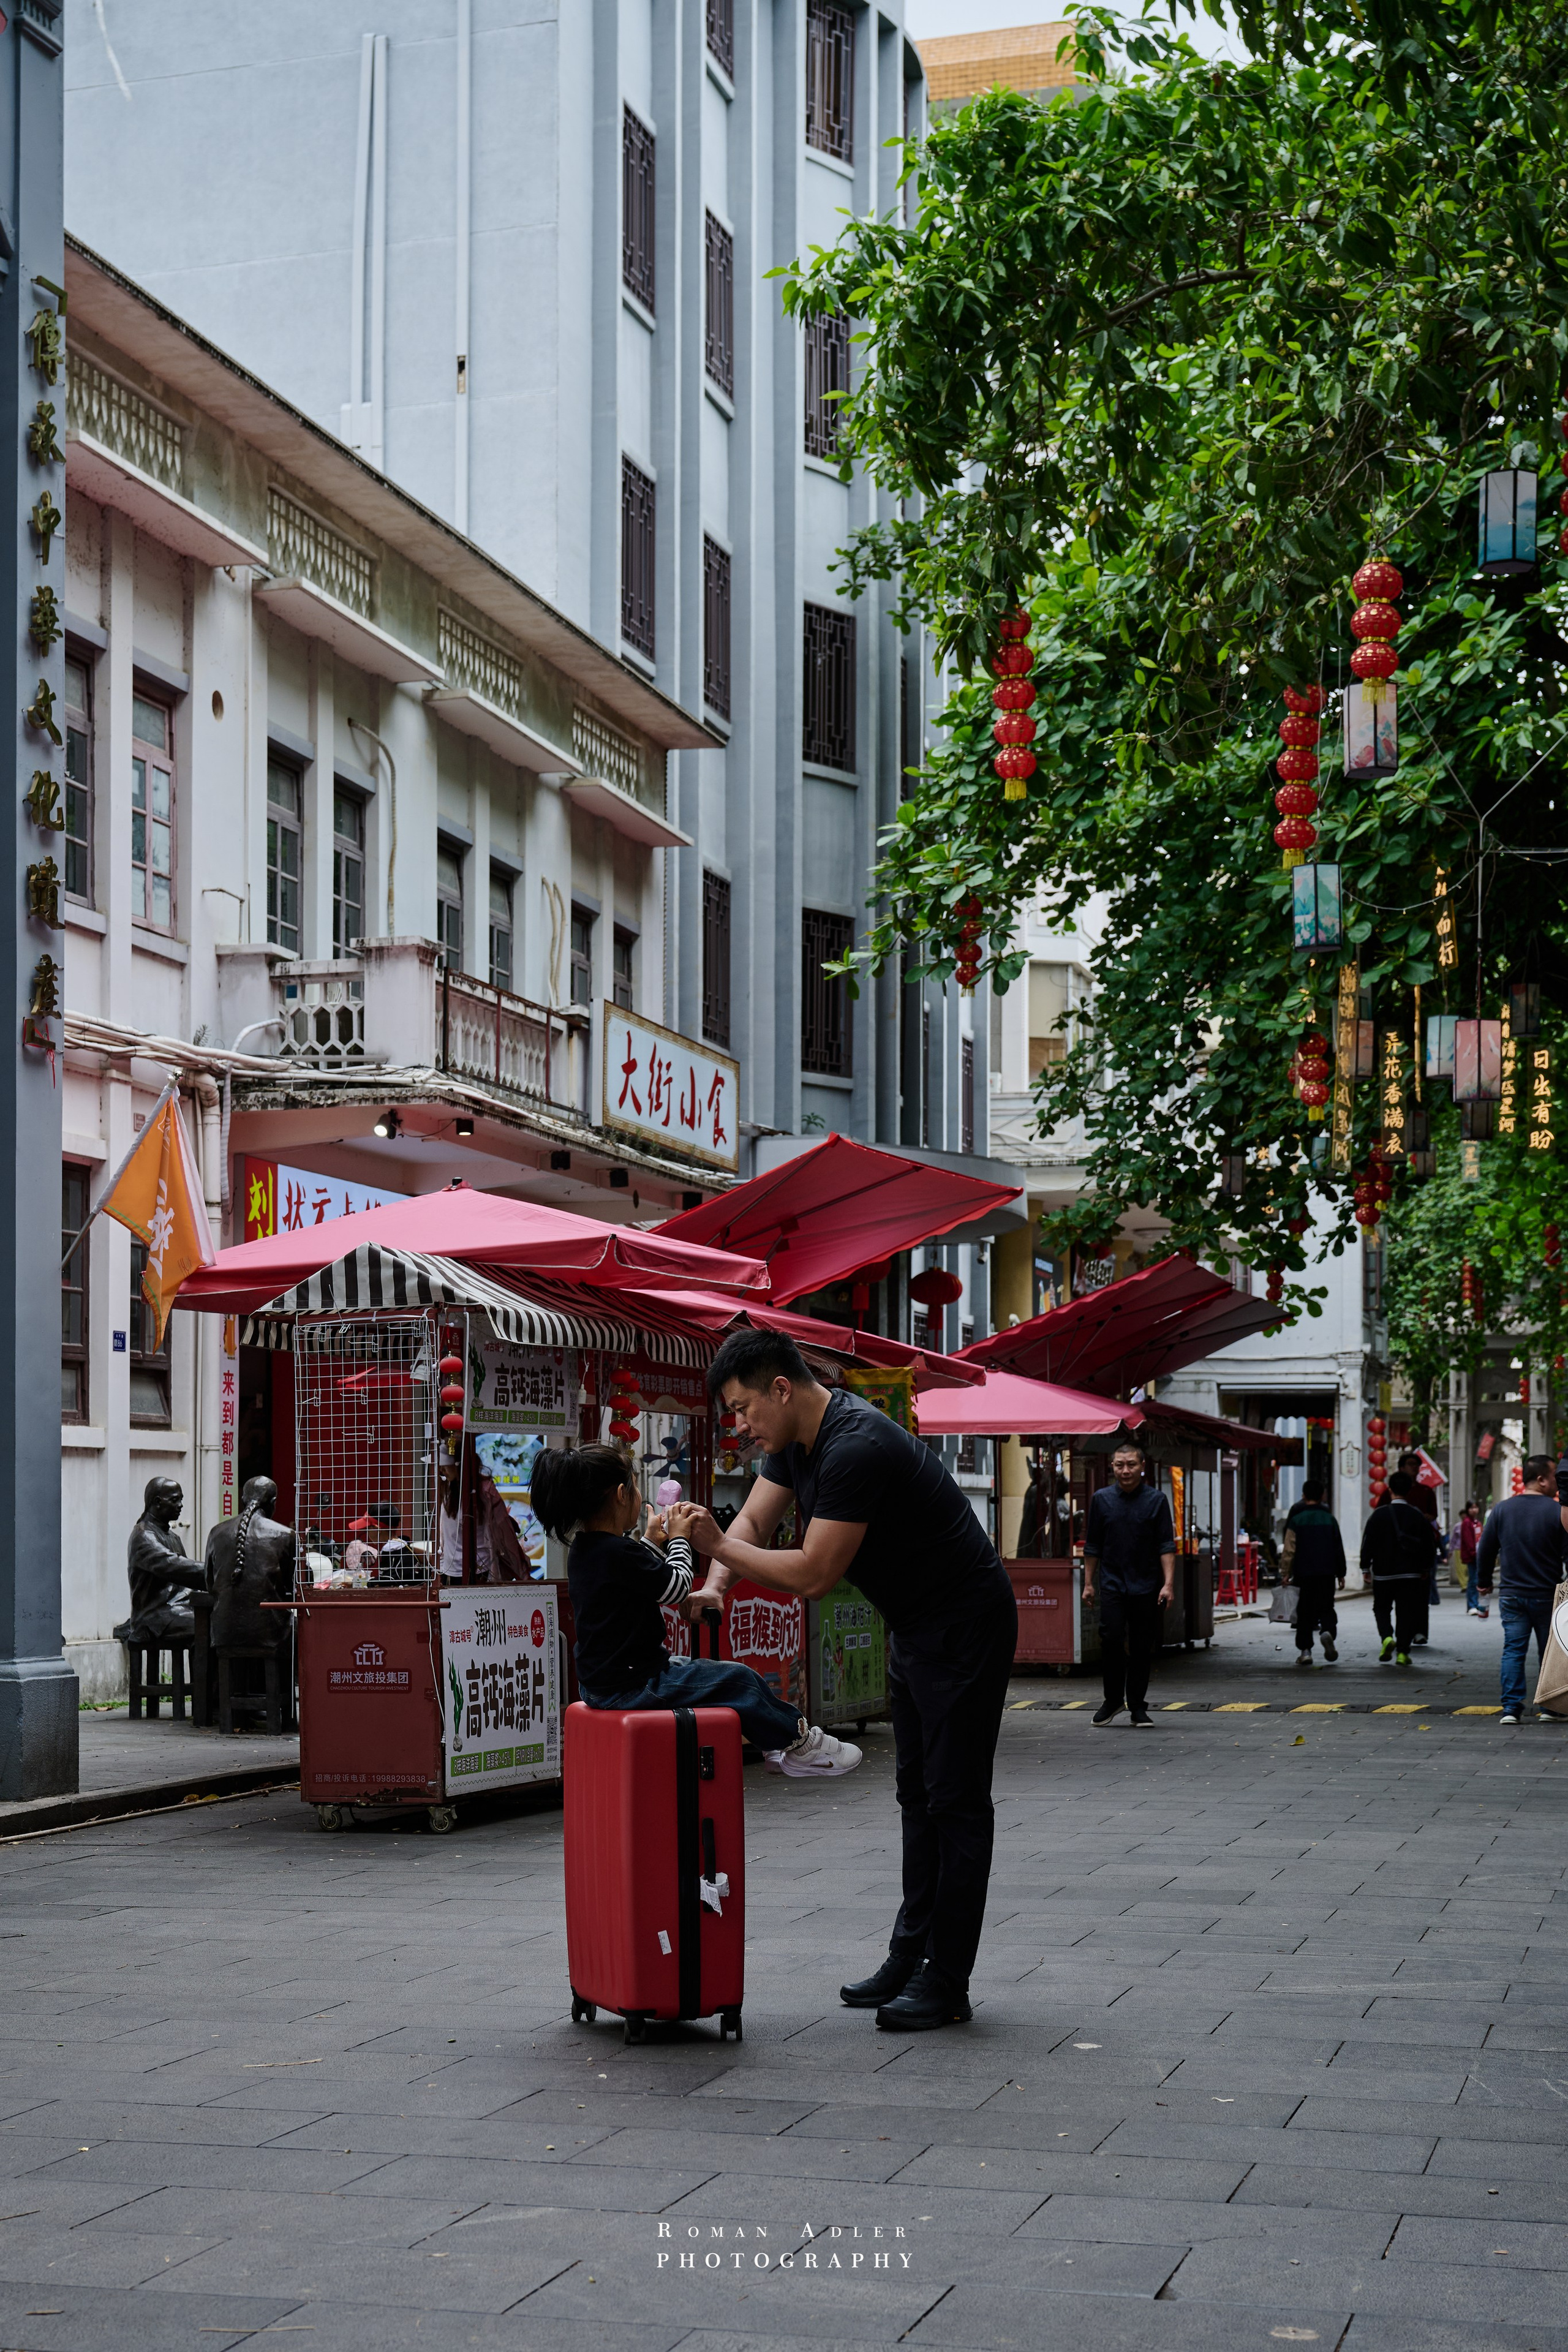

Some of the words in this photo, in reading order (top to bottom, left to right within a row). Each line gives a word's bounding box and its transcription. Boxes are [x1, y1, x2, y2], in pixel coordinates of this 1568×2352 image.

[618, 1030, 727, 1148] 大街小食
[1382, 1031, 1405, 1155] 弄花香满衣
[1529, 1049, 1555, 1150] 日出有盼
[247, 1166, 274, 1240] 刘
[494, 1362, 565, 1410] 高钙海藻片
[221, 1370, 235, 1517] 来到都是自
[474, 1608, 507, 1647] 潮州
[507, 1624, 529, 1638] 特色美食
[531, 1627, 545, 1639] 水产品
[330, 1671, 409, 1684] 潮州文旅投集团
[466, 1653, 545, 1739] 高钙海藻片
